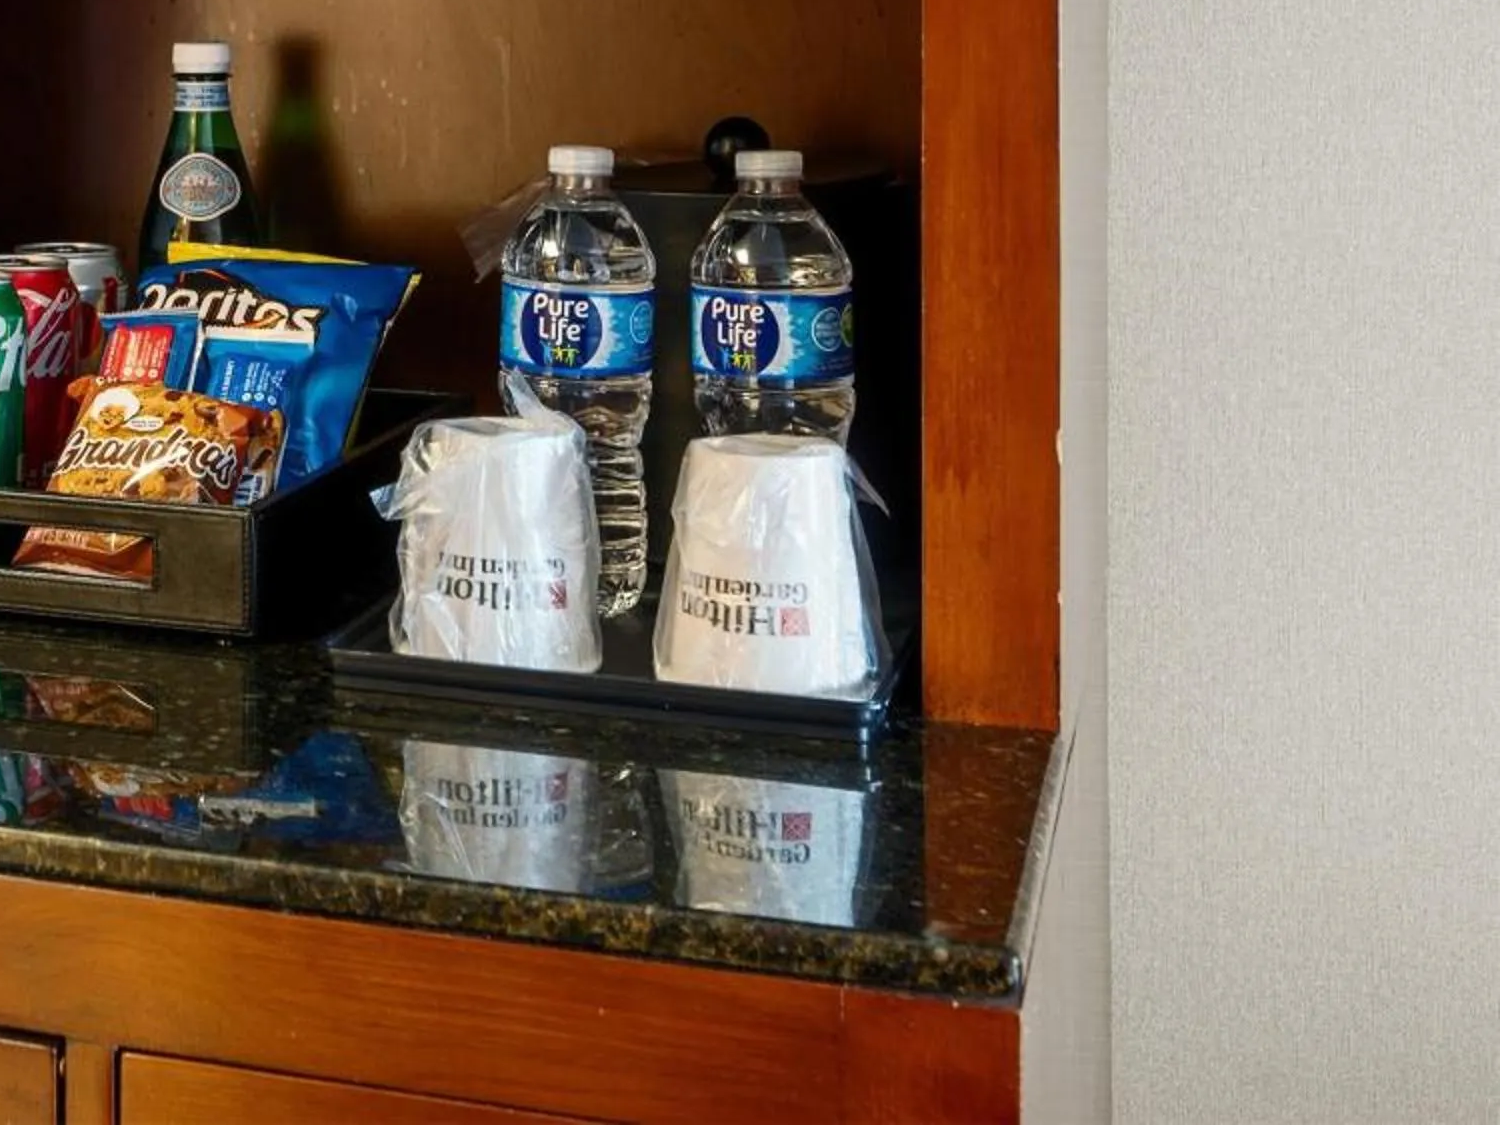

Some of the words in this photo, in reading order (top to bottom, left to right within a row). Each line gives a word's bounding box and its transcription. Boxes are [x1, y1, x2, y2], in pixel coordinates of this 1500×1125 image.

[533, 292, 589, 318] Pure
[711, 296, 766, 324] Pure
[538, 315, 583, 348] Life
[716, 321, 758, 353] Life
[436, 575, 543, 611] ilton
[680, 589, 777, 637] Hilton
